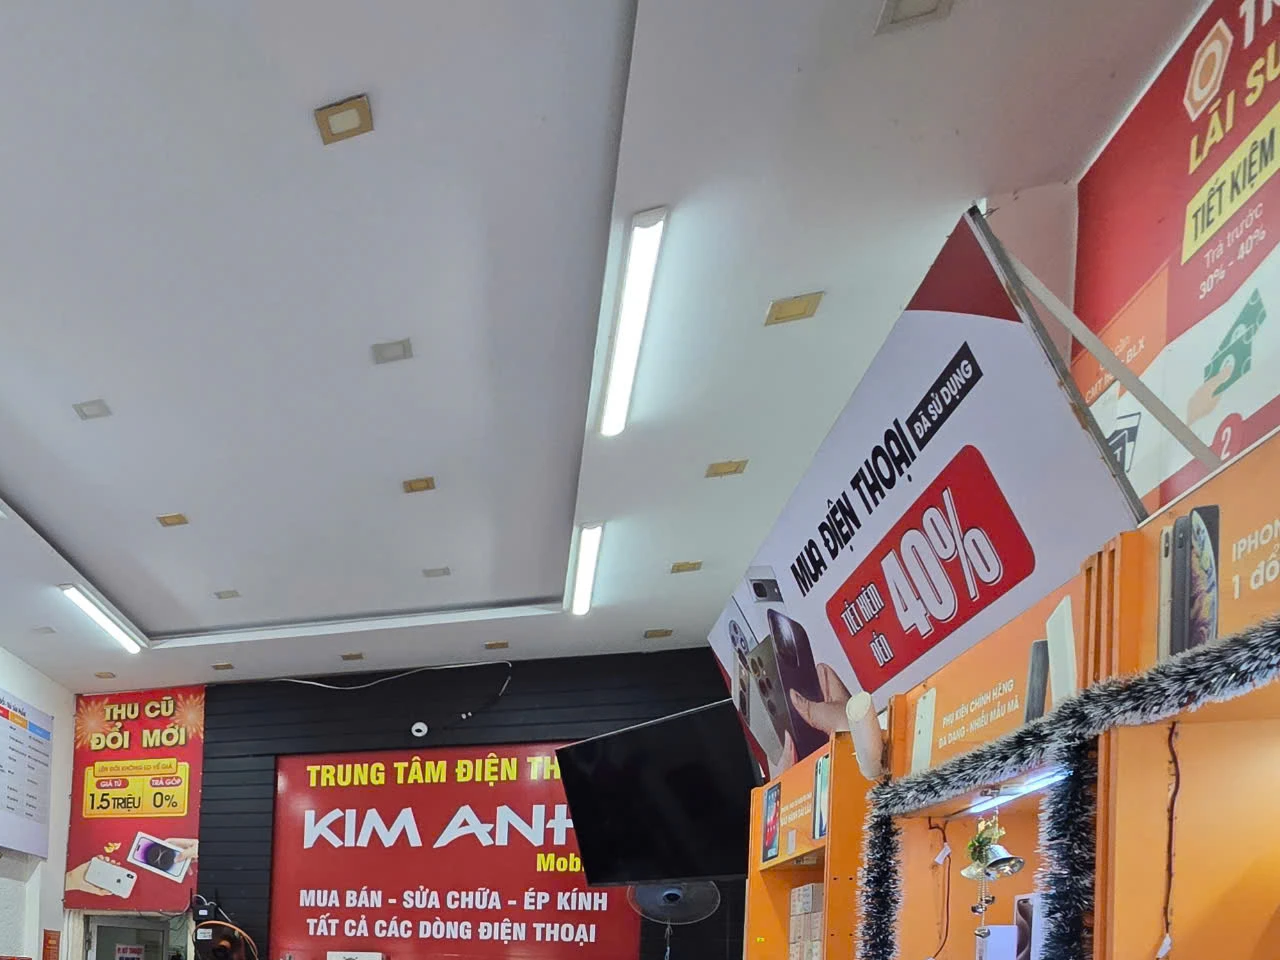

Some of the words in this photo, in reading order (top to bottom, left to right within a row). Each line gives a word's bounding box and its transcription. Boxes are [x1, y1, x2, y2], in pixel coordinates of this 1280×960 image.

[1192, 176, 1226, 241] TIẾT
[1230, 128, 1275, 203] KIỆM
[1199, 267, 1226, 300] 30%
[1237, 228, 1266, 260] 40%
[913, 411, 932, 439] ĐÃ
[927, 392, 944, 422] SỬ
[940, 360, 973, 407] DỤNG
[790, 539, 828, 597] MUA
[818, 491, 862, 561] ĐIỆN
[850, 417, 917, 515] THOẠI
[880, 486, 1004, 639] 40%
[104, 703, 139, 721] THU
[144, 696, 175, 718] CŨ
[90, 722, 130, 751] ĐỔI
[142, 723, 186, 748] MỚI
[100, 780, 112, 788] GIÁ
[165, 776, 181, 785] GÓP
[307, 763, 385, 788] TRUNG
[393, 756, 447, 784] TÂM
[455, 752, 517, 787] ĐIỆN
[89, 793, 111, 810] 1.5
[111, 794, 141, 812] TRIỆU
[152, 791, 178, 808] 0%
[303, 807, 422, 848] KIM
[536, 853, 585, 873] Mob
[299, 889, 339, 909] MUA
[345, 885, 382, 909] BÁN
[403, 885, 441, 910] SỬA
[446, 887, 501, 910] CHỮA
[523, 887, 549, 911] ÉP
[557, 889, 608, 912] KÍNH
[306, 913, 338, 937] TẤT
[344, 914, 369, 938] CẢ
[374, 916, 412, 938] CÁC
[419, 916, 471, 940] DÒNG
[478, 918, 526, 944] ĐIỆN
[532, 922, 596, 946] THOẠI
